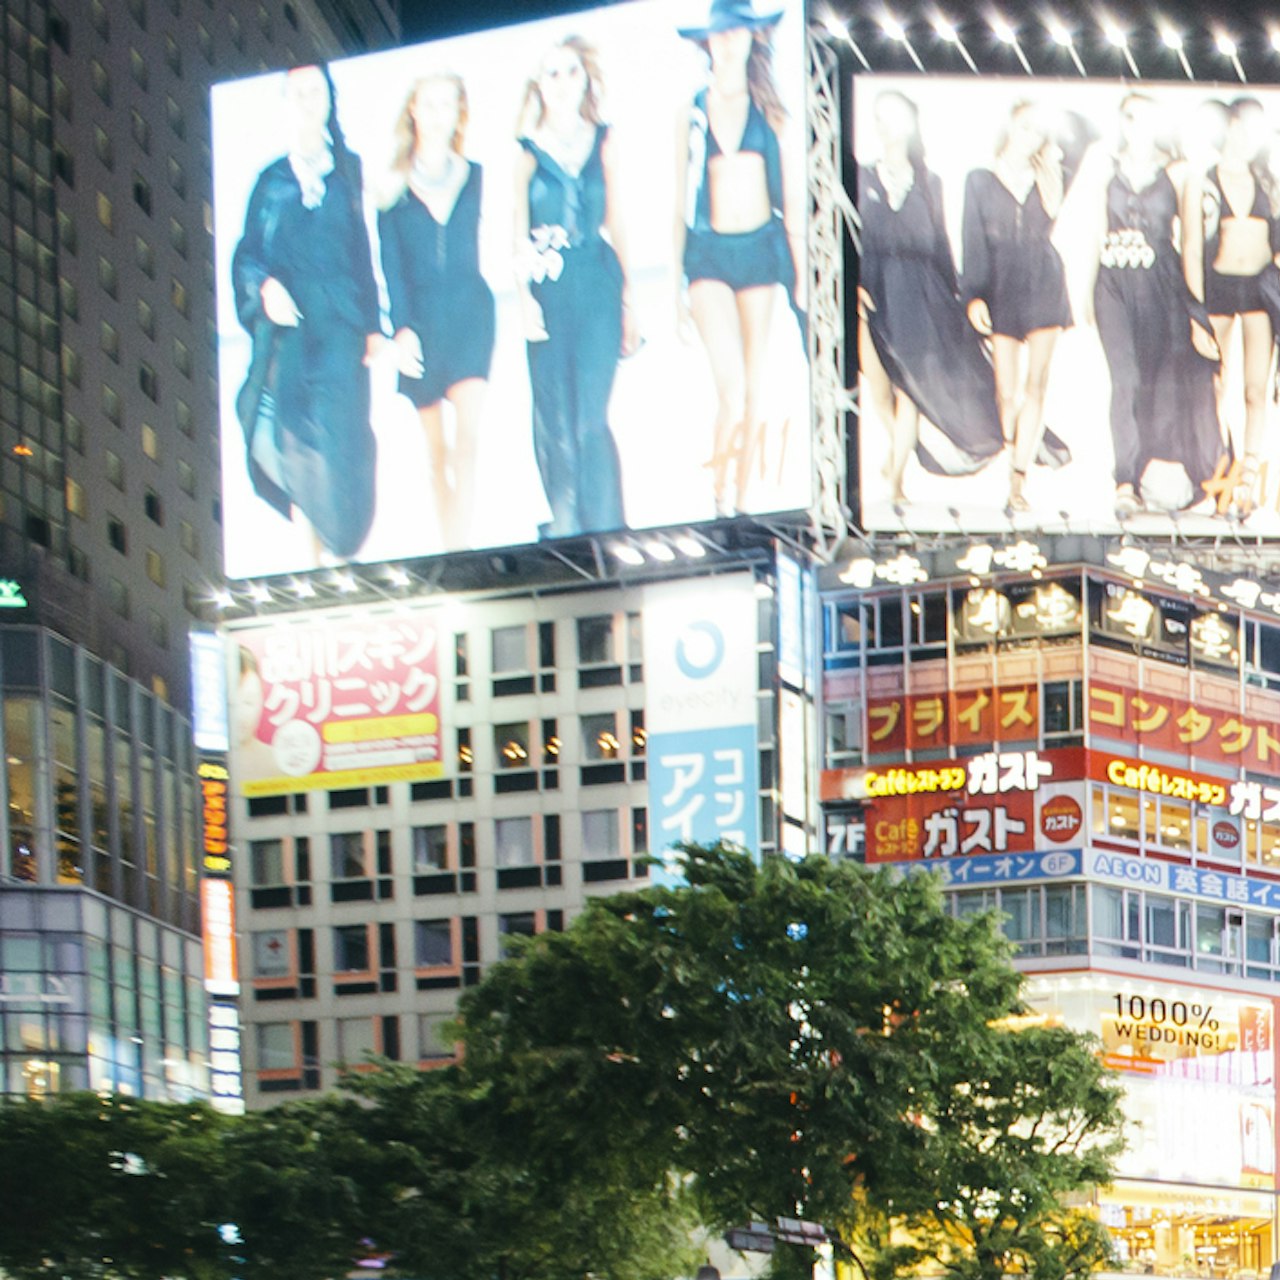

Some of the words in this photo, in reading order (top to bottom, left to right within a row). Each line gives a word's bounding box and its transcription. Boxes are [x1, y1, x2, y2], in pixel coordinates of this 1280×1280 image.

[264, 667, 437, 726] クリニック
[868, 689, 1034, 741] プライス
[966, 751, 1053, 795] ガスト
[826, 823, 865, 855] 7F
[924, 806, 1026, 857] ガスト
[1045, 815, 1080, 831] ガスト
[1047, 856, 1068, 870] 6F
[1093, 854, 1162, 885] AEON
[1113, 992, 1220, 1032] 1000%
[1114, 1021, 1220, 1050] WEDDING!
